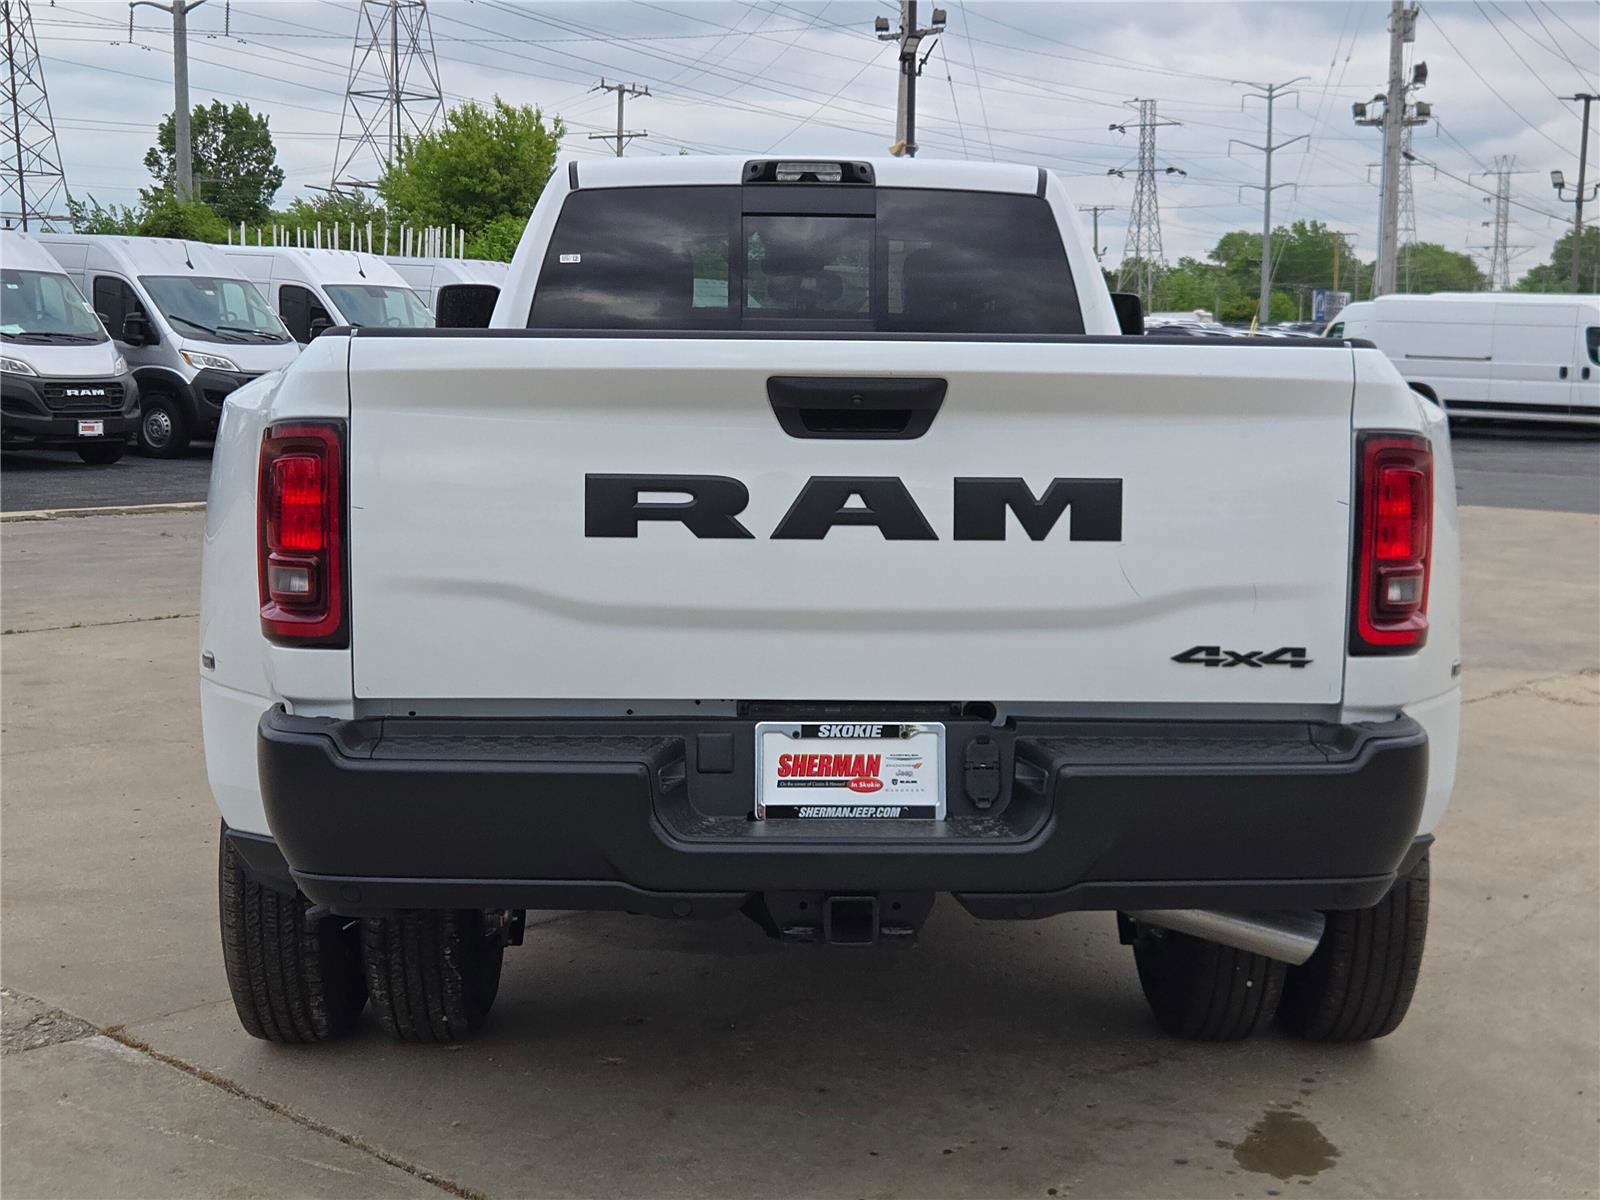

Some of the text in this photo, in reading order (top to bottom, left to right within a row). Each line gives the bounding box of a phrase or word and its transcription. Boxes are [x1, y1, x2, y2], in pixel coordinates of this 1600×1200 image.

[585, 473, 1123, 541] RAM
[1170, 645, 1314, 668] 4x4
[818, 725, 883, 738] SKOKIE
[777, 754, 882, 778] SHERMAN
[799, 807, 901, 818] SHERMANJEEP.COM
